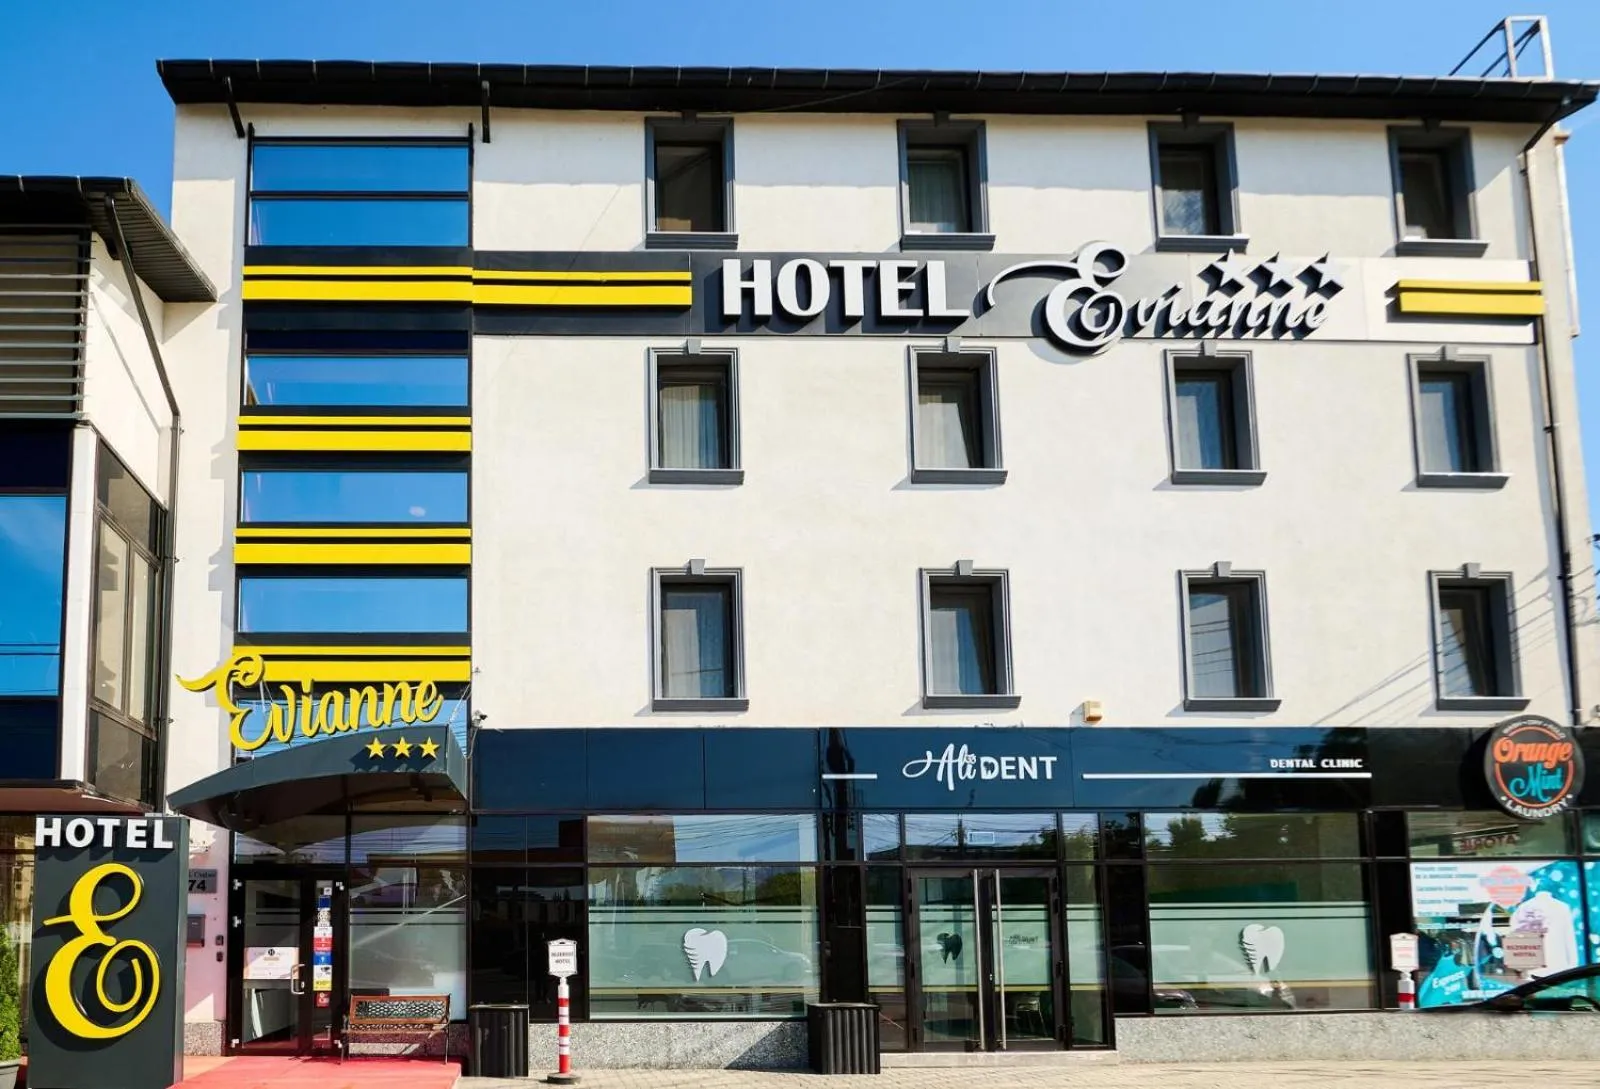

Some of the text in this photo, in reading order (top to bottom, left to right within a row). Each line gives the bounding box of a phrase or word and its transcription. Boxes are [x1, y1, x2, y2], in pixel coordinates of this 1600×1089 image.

[722, 241, 1329, 349] HOTEL Evianne
[175, 653, 443, 750] Evianne
[1270, 758, 1363, 769] DENTAL CLINIC
[1493, 736, 1573, 769] Orange
[1509, 762, 1563, 803] Mint
[1504, 797, 1568, 818] LAUNDRY
[35, 817, 173, 849] HOTEL
[188, 879, 206, 891] 74
[43, 863, 161, 1039] E
